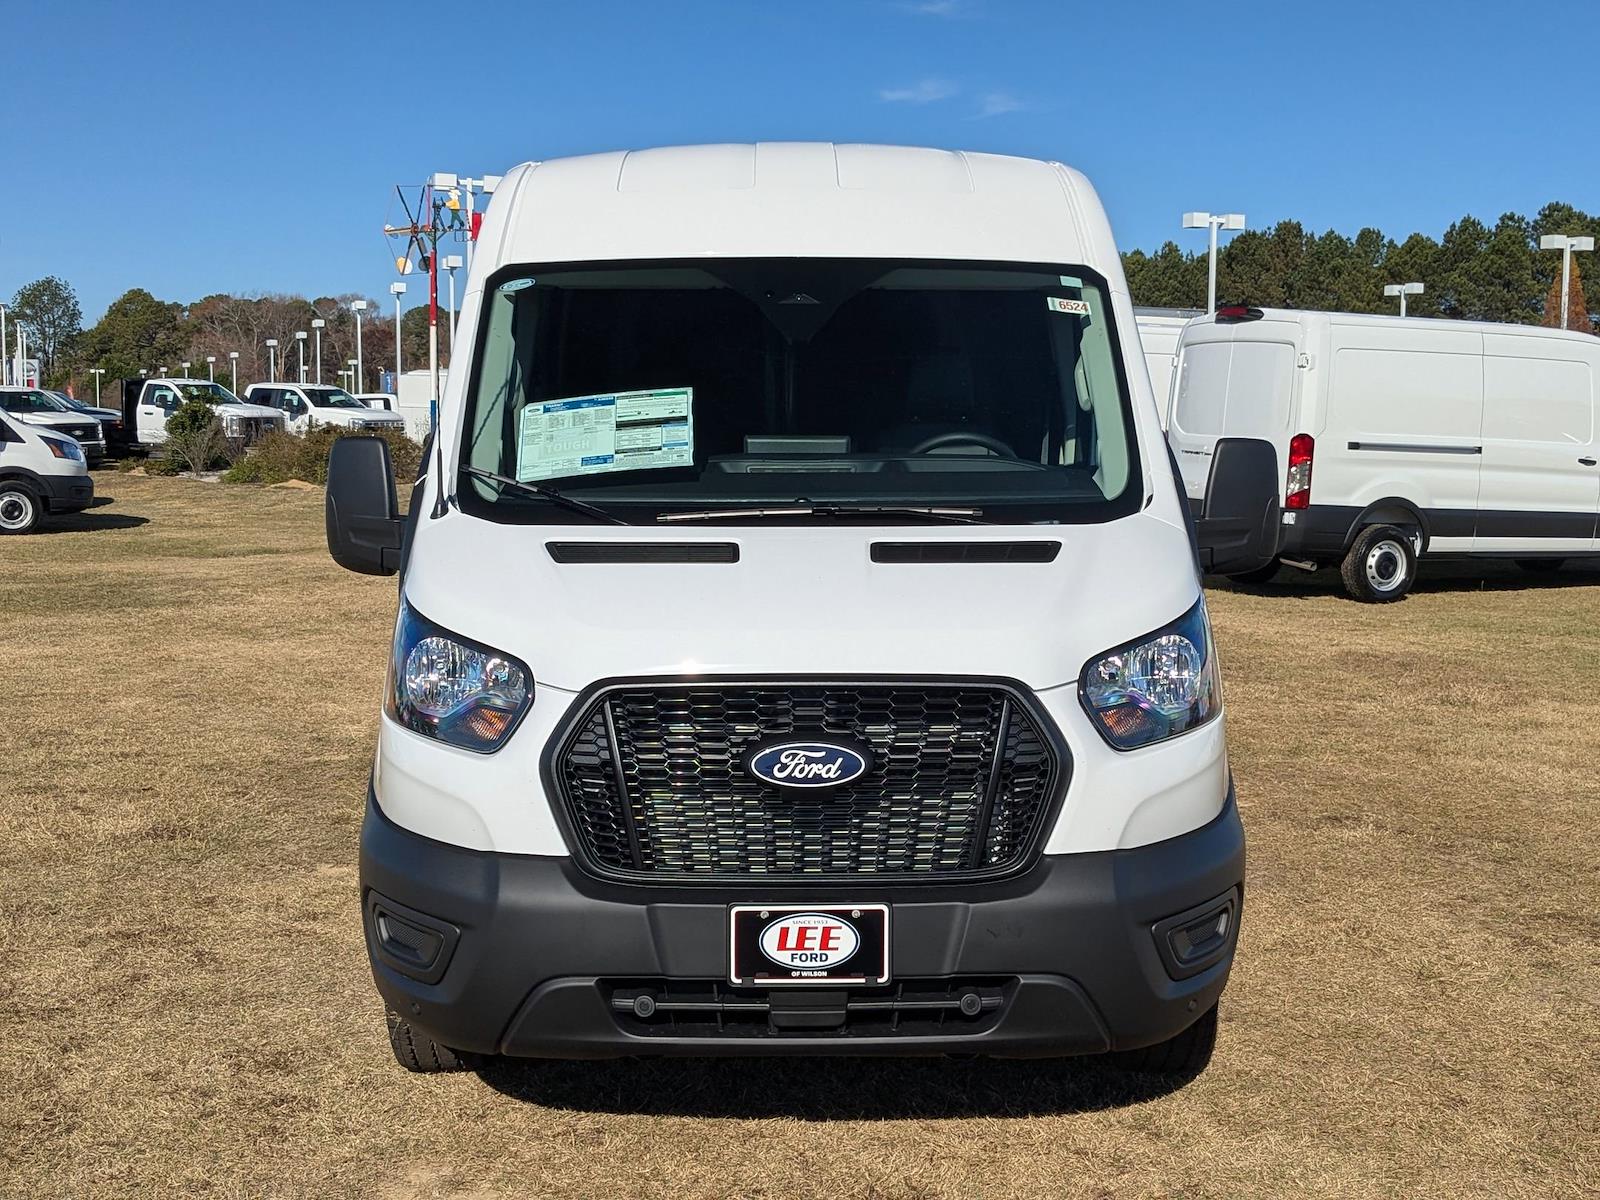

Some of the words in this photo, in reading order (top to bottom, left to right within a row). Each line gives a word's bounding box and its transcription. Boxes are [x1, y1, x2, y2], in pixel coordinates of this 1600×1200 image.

[1058, 300, 1089, 313] 6524
[772, 749, 844, 779] Ford
[776, 925, 843, 952] LEE
[790, 952, 829, 963] FORD
[791, 970, 801, 978] OF
[801, 970, 828, 978] WILSON
